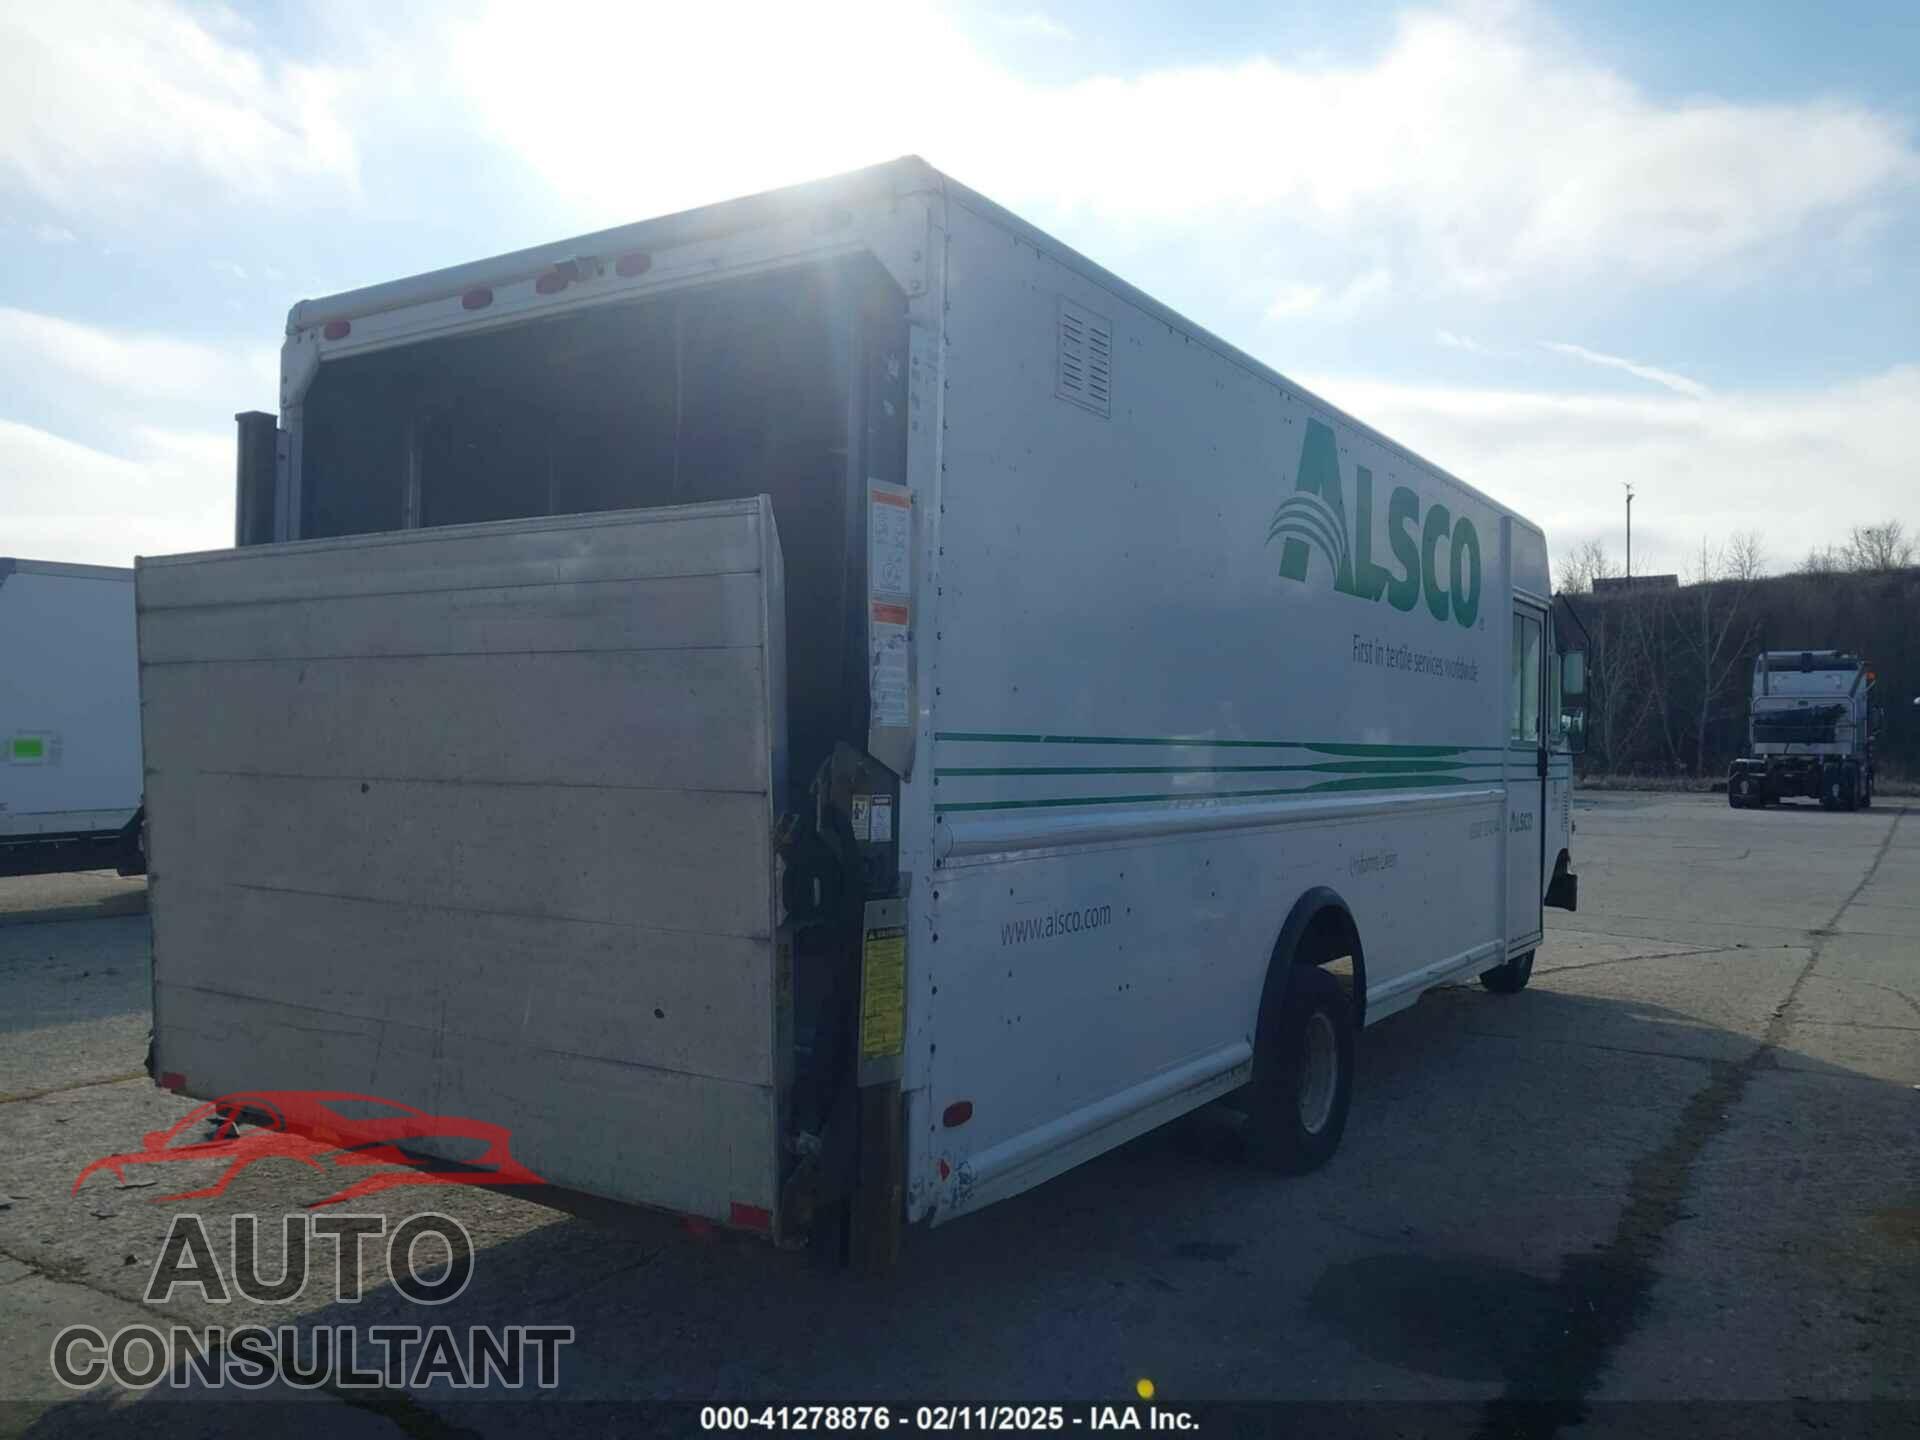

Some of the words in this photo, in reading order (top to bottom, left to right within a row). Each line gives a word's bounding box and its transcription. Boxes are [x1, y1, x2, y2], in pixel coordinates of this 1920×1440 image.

[1265, 417, 1482, 629] ALSCO
[1353, 634, 1373, 664] First
[1375, 637, 1384, 665] in
[1385, 643, 1412, 671] textile
[1414, 650, 1443, 677] services
[1001, 904, 1112, 946] www.alsco.com
